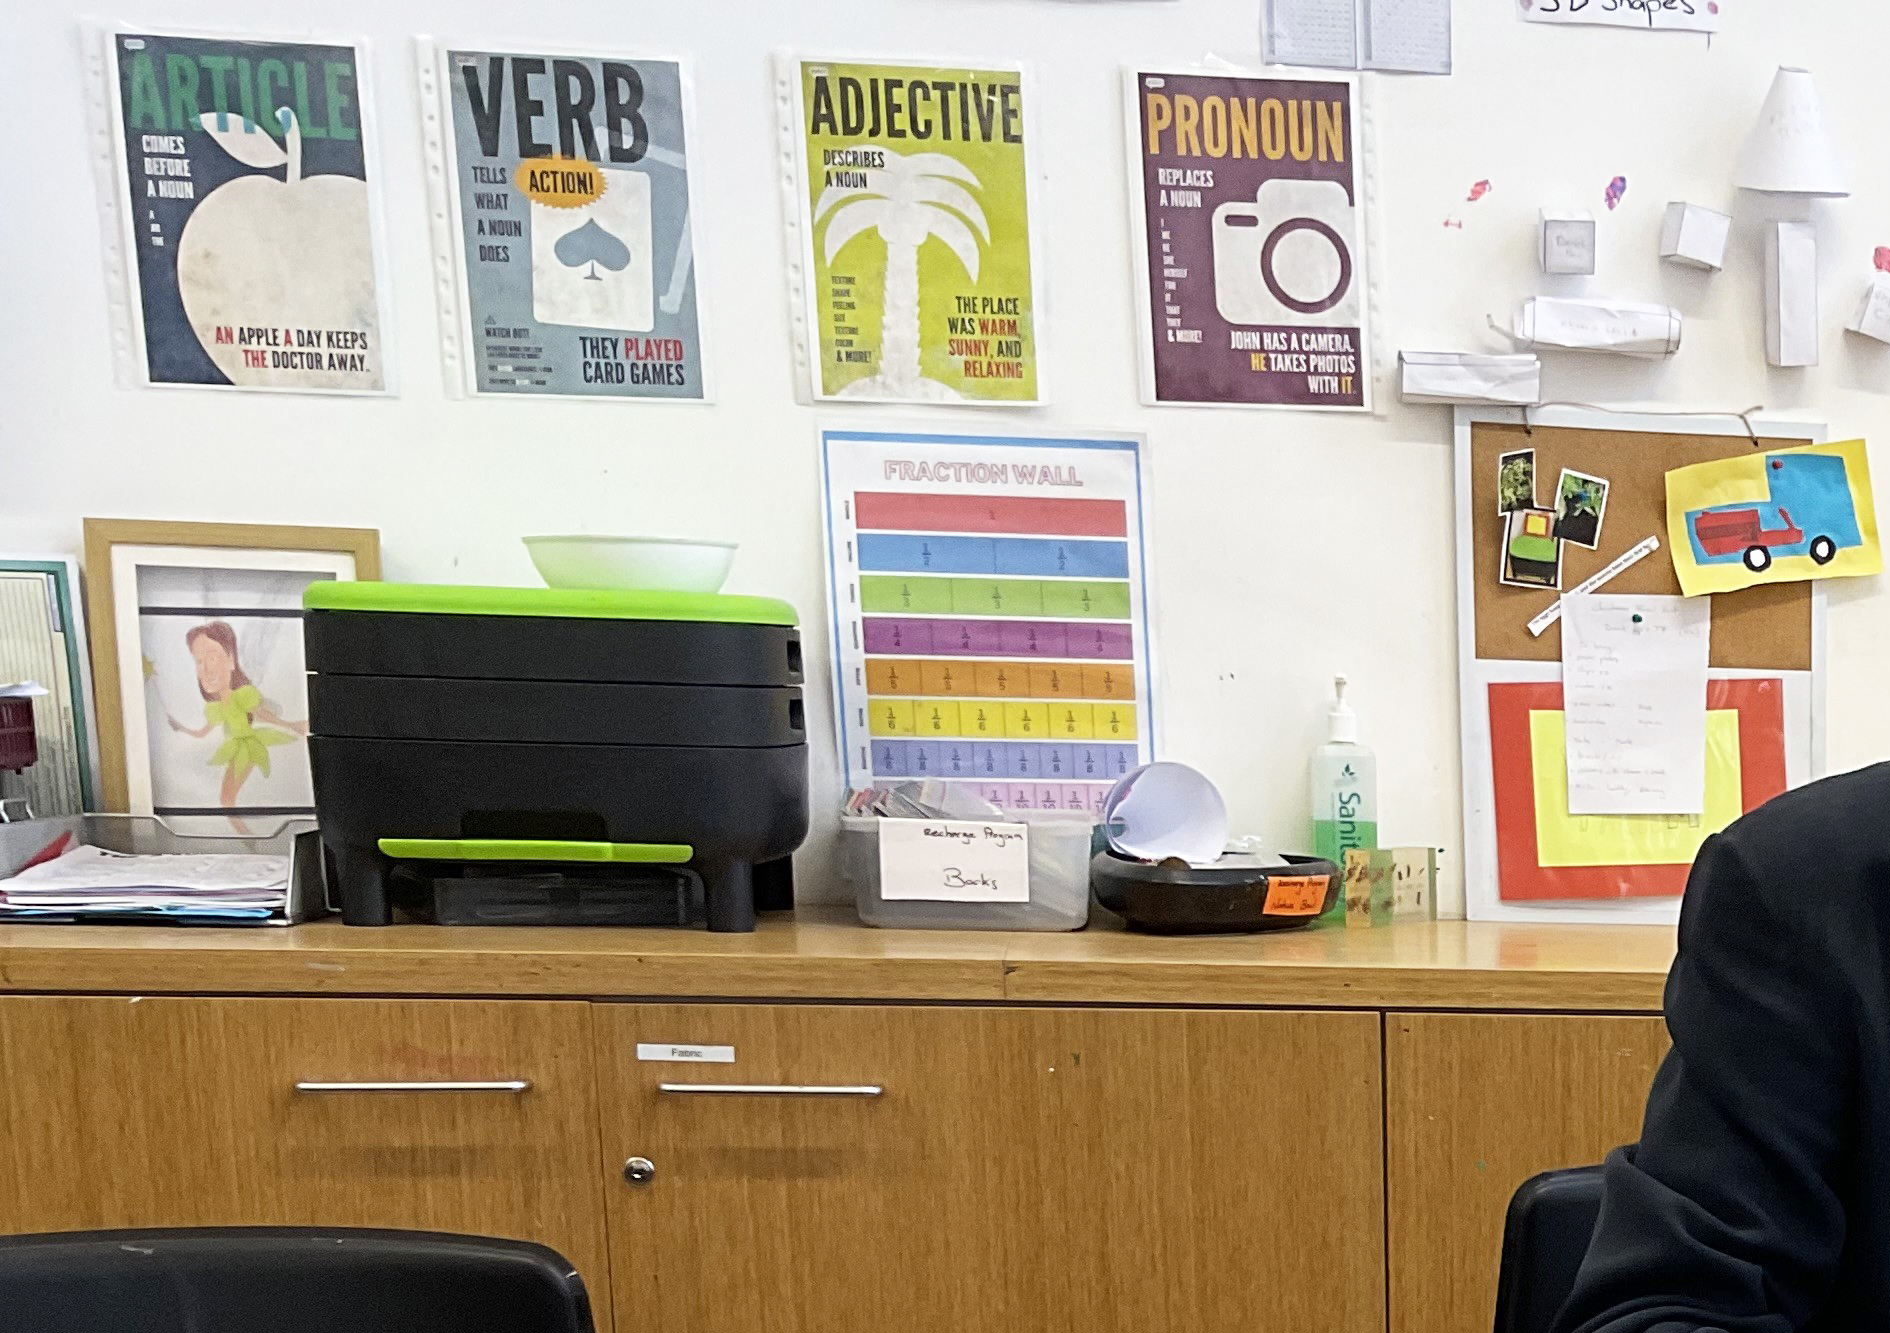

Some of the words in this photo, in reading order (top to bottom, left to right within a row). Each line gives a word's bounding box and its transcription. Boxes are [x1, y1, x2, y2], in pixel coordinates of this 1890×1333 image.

[128, 51, 358, 141] ARTICLE
[462, 56, 649, 163] VERB
[811, 75, 1023, 144] ADJECTIVE
[1146, 92, 1344, 163] PRONOUN
[142, 134, 185, 154] COMES
[144, 157, 191, 177] BEFORE
[823, 149, 885, 169] DESCRIBES
[472, 166, 507, 184] TELLS
[529, 170, 594, 195] ACTION!
[825, 171, 834, 188] A
[836, 171, 867, 189] NOUN
[1158, 168, 1214, 187] REPLACES
[147, 180, 157, 197] A
[159, 181, 194, 199] NOUN
[1160, 190, 1168, 207] A
[1170, 190, 1202, 208] NOUN
[475, 193, 508, 210] WHAT
[477, 219, 485, 235] A
[489, 219, 522, 237] NOUN
[479, 244, 510, 263] DOES
[955, 296, 978, 314] THE
[982, 297, 1020, 316] PLACE
[948, 317, 976, 336] WAS
[978, 318, 1021, 338] WARM,
[215, 326, 233, 344] AN
[239, 327, 280, 346] APPLE
[284, 329, 293, 347] A
[297, 329, 323, 348] DAY
[327, 331, 368, 350] KEEPS
[1231, 330, 1260, 350] JOHN
[1263, 332, 1288, 351] HAS
[1291, 333, 1299, 351] A
[1302, 334, 1355, 353] CAMERA.
[579, 336, 620, 360] THEY
[624, 337, 684, 362] PLAYED
[949, 339, 994, 359] SUNNY,
[997, 340, 1022, 359] AND
[242, 349, 269, 368] THE
[272, 350, 324, 370] DOCTOR
[328, 353, 370, 372] AWAY.
[964, 361, 1024, 379] RELAXING
[1251, 353, 1267, 371] HE
[1269, 354, 1307, 372] TAKES
[1309, 355, 1356, 374] PHOTOS
[583, 361, 625, 384] CARD
[630, 363, 685, 386] GAMES
[1308, 375, 1339, 394] WITH
[884, 460, 1009, 484] FRACTION
[1012, 464, 1084, 487] WALL
[1338, 791, 1361, 865] Sanit
[671, 1047, 703, 1058] Fabric
